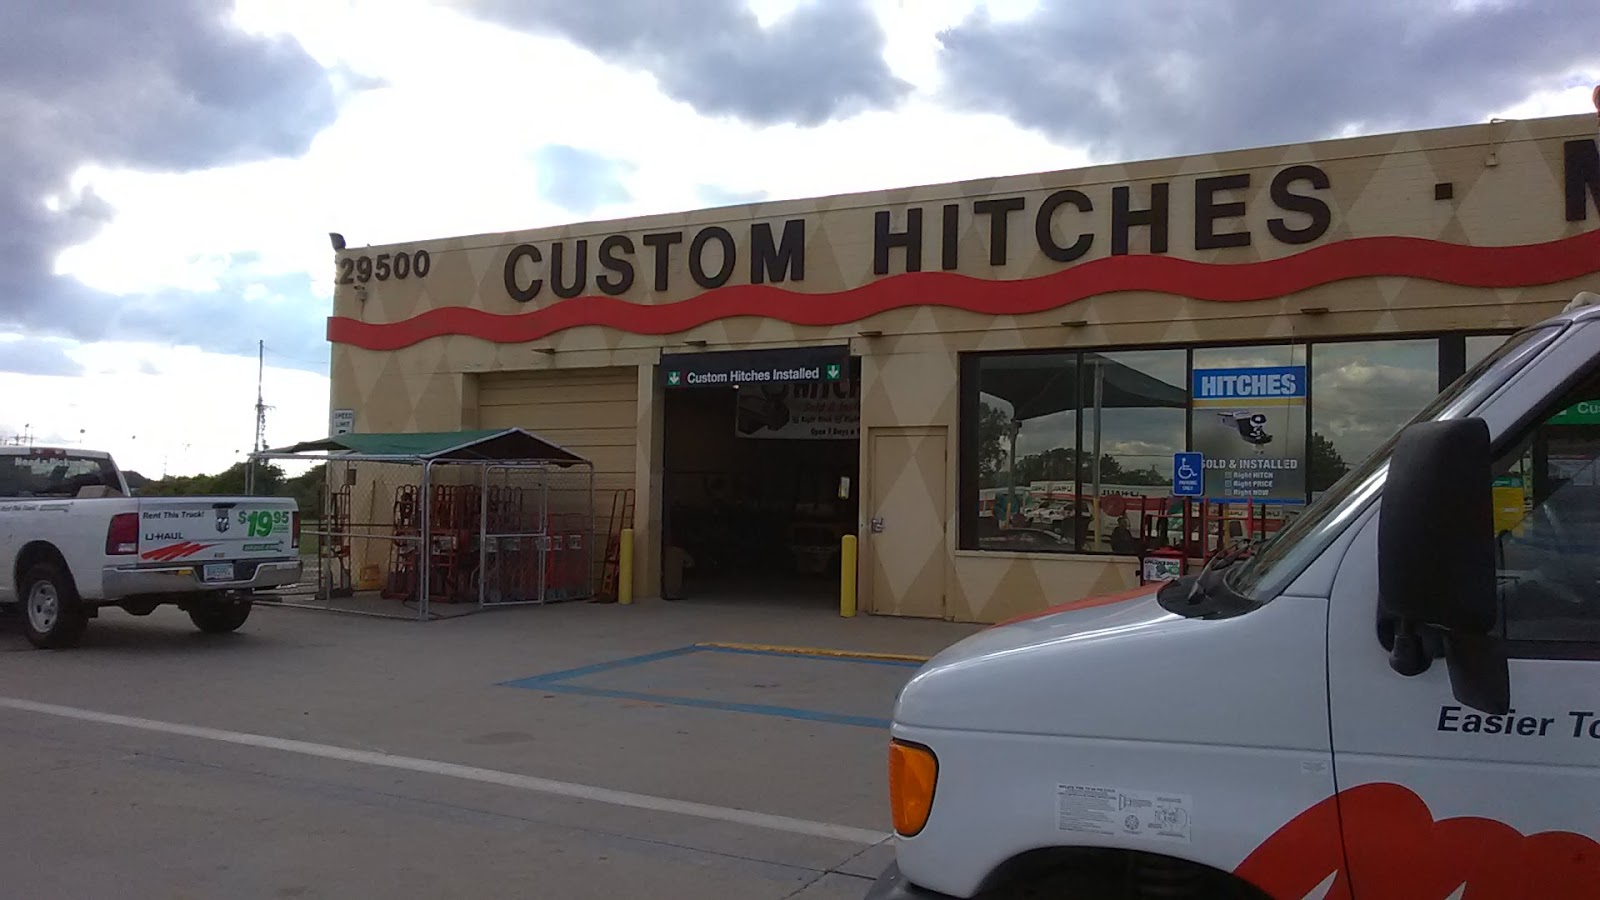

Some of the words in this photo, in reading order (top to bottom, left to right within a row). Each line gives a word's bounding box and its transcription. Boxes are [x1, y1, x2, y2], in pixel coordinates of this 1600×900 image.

[504, 219, 805, 302] CUSTOM
[873, 164, 1332, 275] HITCHES
[339, 249, 431, 285] 29500
[687, 371, 728, 384] Custom
[730, 369, 771, 383] Hitches
[772, 367, 820, 381] Installed
[1201, 373, 1297, 396] HITCHES
[1577, 401, 1600, 414] Cu
[334, 412, 353, 420] SPEED
[1201, 459, 1226, 469] SOLD
[1228, 459, 1237, 469] &
[1239, 459, 1298, 469] INSTALLED
[1233, 472, 1252, 480] Right
[1252, 471, 1274, 479] HITCH
[1233, 480, 1252, 488] Right
[1252, 480, 1273, 488] PRICE
[1233, 489, 1252, 497] Right
[164, 511, 179, 519] This
[145, 531, 184, 541] U-HAUL
[1437, 705, 1555, 736] Easier
